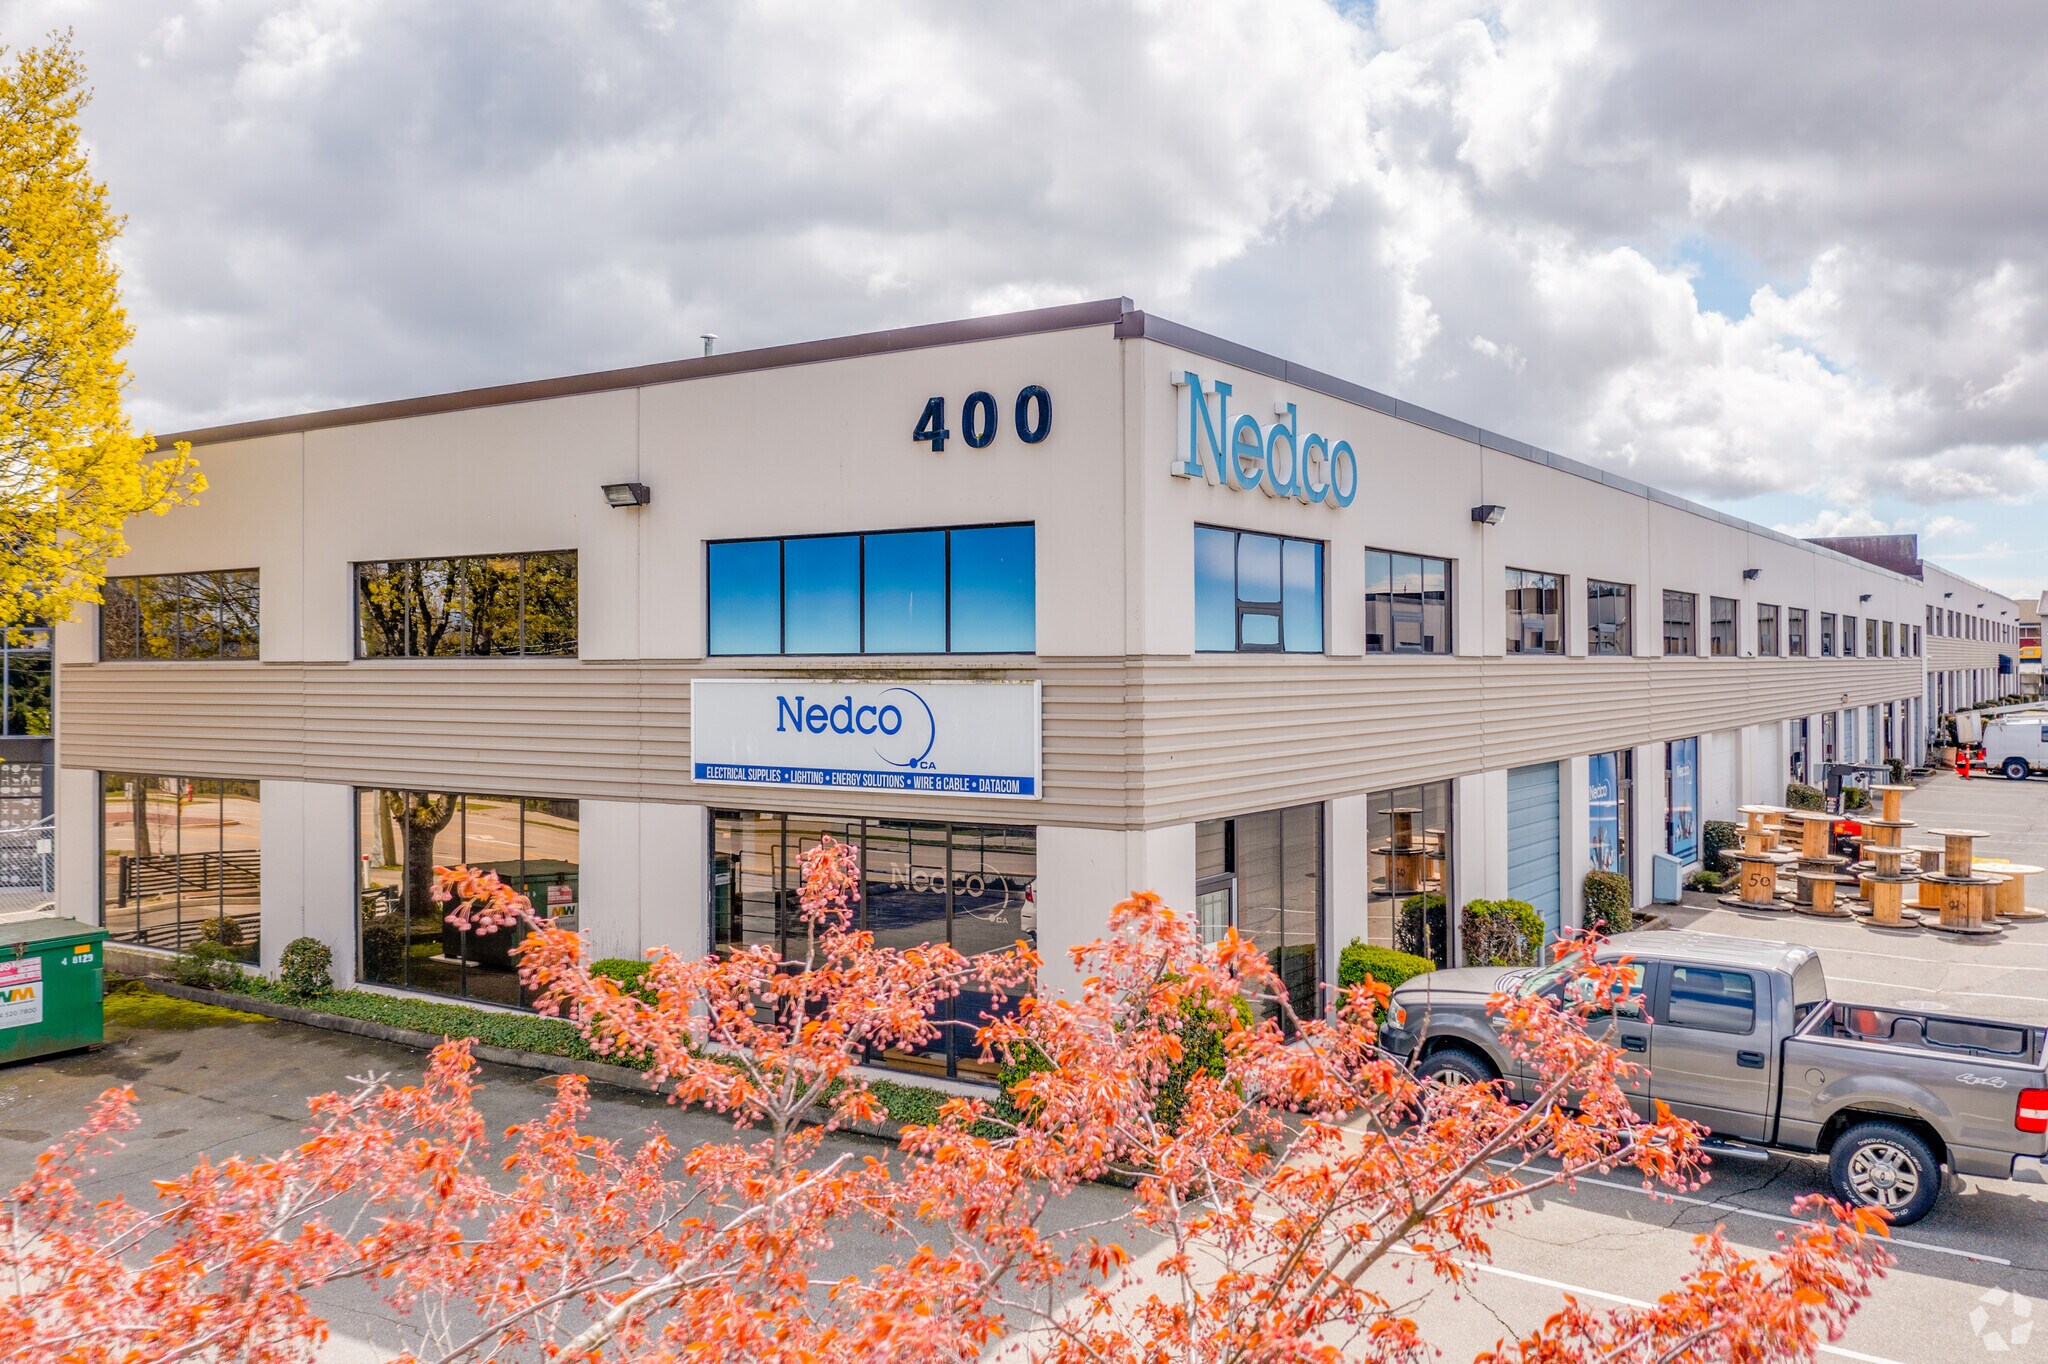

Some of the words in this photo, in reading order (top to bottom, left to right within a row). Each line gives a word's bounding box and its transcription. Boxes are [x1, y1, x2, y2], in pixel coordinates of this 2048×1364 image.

[912, 384, 1053, 453] 400
[1171, 370, 1358, 508] Nedco
[776, 695, 903, 736] Nedco
[706, 766, 747, 780] ELECTRICAL
[748, 768, 781, 782] SUPPLIES
[790, 770, 824, 784] LIGHTING
[831, 772, 861, 786] ENERGY
[862, 773, 905, 788] SOLUTIONS
[913, 775, 934, 789] WIRE
[935, 776, 942, 789] &
[943, 777, 970, 791] CABLE
[979, 778, 1020, 794] DATACOM
[919, 761, 937, 770] CA
[1749, 873, 1770, 887] 50
